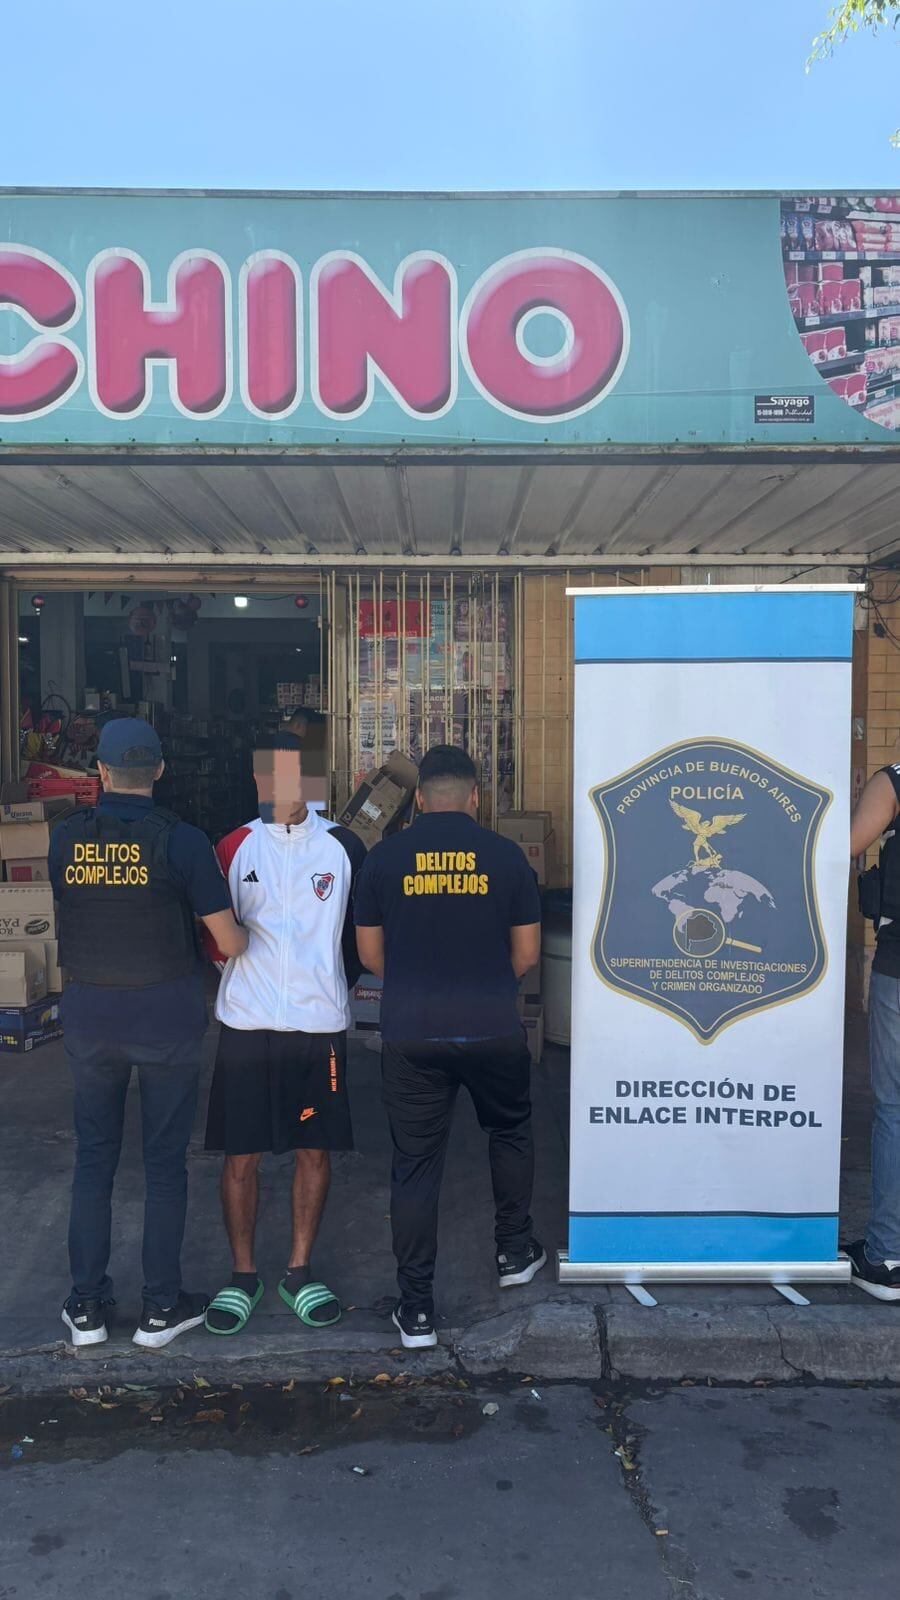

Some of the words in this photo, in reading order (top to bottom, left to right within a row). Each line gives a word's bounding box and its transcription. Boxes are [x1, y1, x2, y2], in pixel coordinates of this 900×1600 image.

[770, 396, 809, 407] Sayago
[617, 765, 682, 814] PROVINCIA
[686, 761, 705, 773] DE
[710, 762, 769, 789] BUENOS
[768, 787, 802, 823] AIRES
[671, 784, 744, 800] POLICÍA
[74, 843, 140, 862] DELITOS
[415, 851, 476, 872] DELITOS
[65, 865, 148, 885] COMPLEJOS
[404, 874, 488, 896] COMPLEJOS
[610, 958, 702, 969] SUPERINTENDENCIA
[704, 959, 718, 969] DE
[720, 961, 807, 973] INVESTIGACIONES
[649, 970, 663, 980] DE
[665, 970, 704, 981] DELITOS
[706, 971, 766, 983] COMPLEJOS
[651, 982, 658, 991] Y
[660, 982, 696, 991] CRIMEN
[699, 982, 763, 994] ORGANIZADO
[615, 1077, 754, 1101] DIRECCIÓN
[763, 1084, 796, 1102] DE
[589, 1106, 687, 1125] ENLACE
[695, 1106, 823, 1128] INTERPOL
